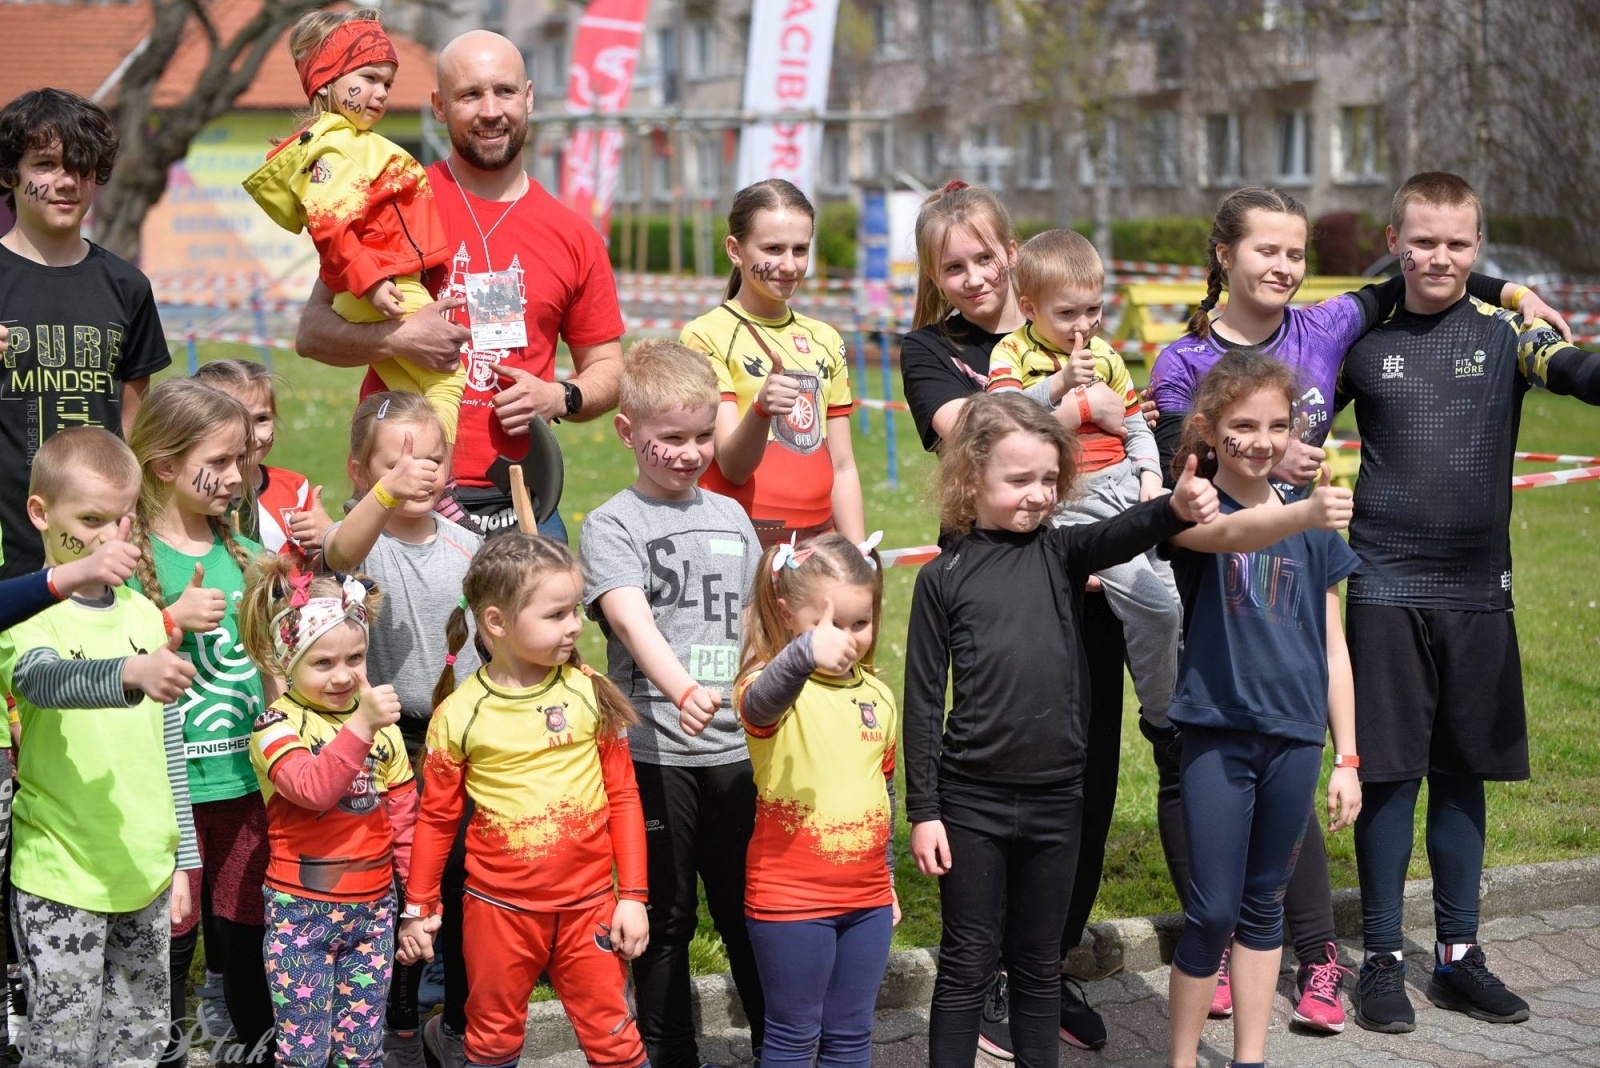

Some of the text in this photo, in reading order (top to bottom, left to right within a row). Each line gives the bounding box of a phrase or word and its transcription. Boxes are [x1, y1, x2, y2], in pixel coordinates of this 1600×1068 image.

[342, 99, 362, 114] 150
[24, 180, 50, 203] 142
[751, 262, 772, 282] 148
[3, 324, 122, 373] PURE
[1455, 364, 1484, 375] MORE
[27, 399, 38, 423] TRUE
[794, 434, 813, 447] OCR
[1222, 436, 1243, 458] 156
[641, 439, 676, 468] 154
[192, 467, 219, 496] 141
[549, 733, 574, 748] ALA
[861, 731, 884, 742] MAJA
[351, 798, 369, 809] OCR
